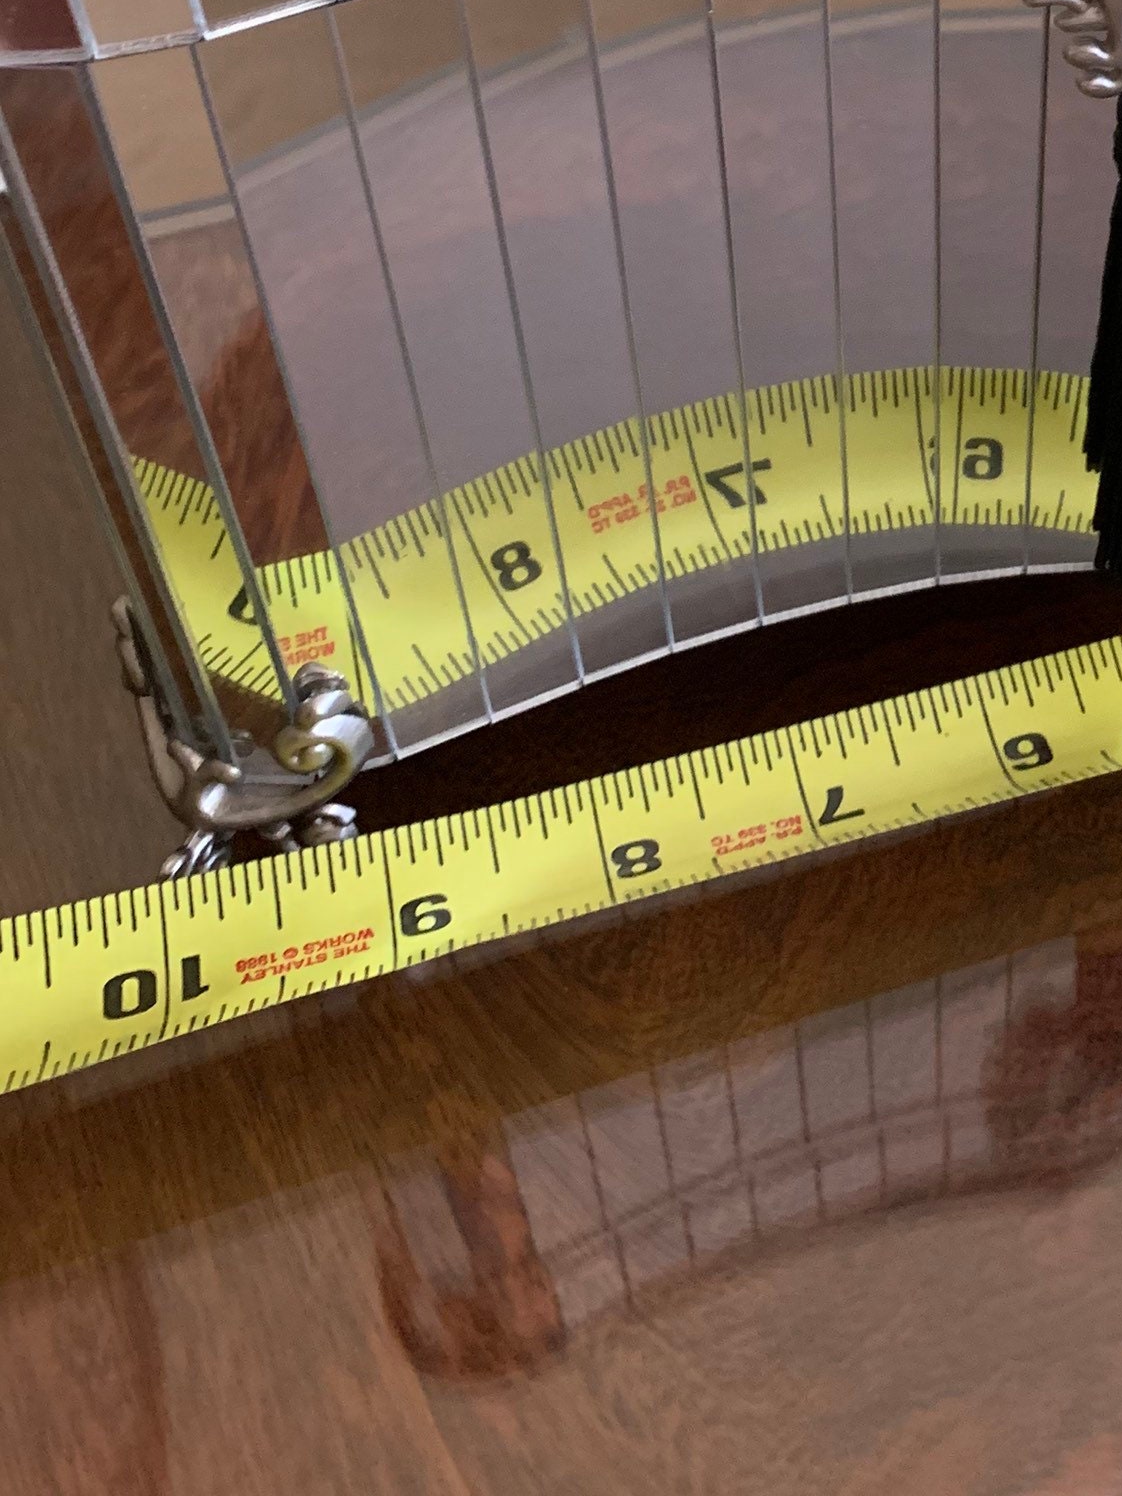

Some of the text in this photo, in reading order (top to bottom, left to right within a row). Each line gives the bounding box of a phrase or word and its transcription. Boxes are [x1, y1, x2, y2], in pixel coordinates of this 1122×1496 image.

[1002, 731, 1055, 772] 6
[818, 785, 866, 826] 7
[609, 838, 664, 880] 8
[399, 893, 453, 937] 9
[303, 927, 375, 955] WORKS
[240, 941, 371, 985] THE STANLEY
[102, 954, 210, 1021] 10
